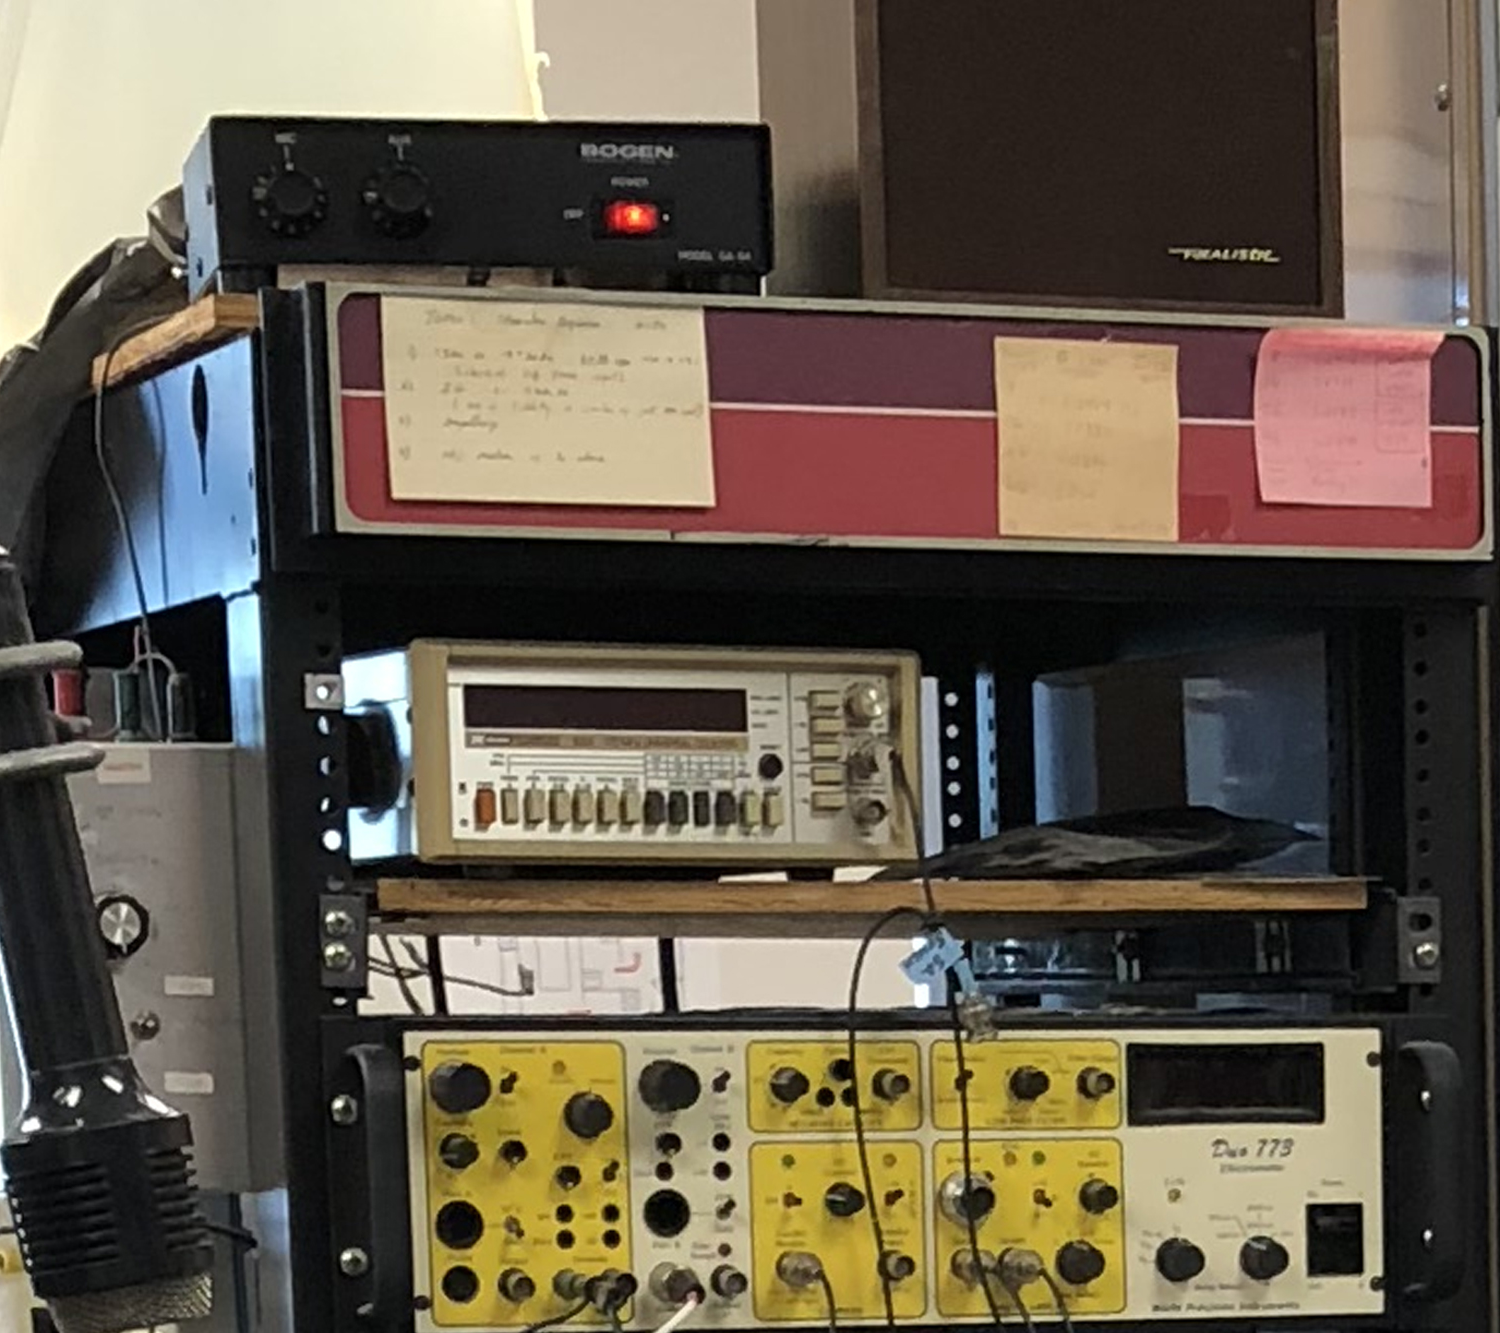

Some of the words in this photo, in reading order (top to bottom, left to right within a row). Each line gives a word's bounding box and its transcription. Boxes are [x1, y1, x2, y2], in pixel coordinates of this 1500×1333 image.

[580, 142, 675, 160] BOGEN
[1167, 247, 1280, 263] REALISTIC
[1211, 1138, 1248, 1159] Duo
[1255, 1138, 1295, 1158] 773
[1186, 1299, 1236, 1313] Precision
[1239, 1298, 1300, 1311] Instruments
